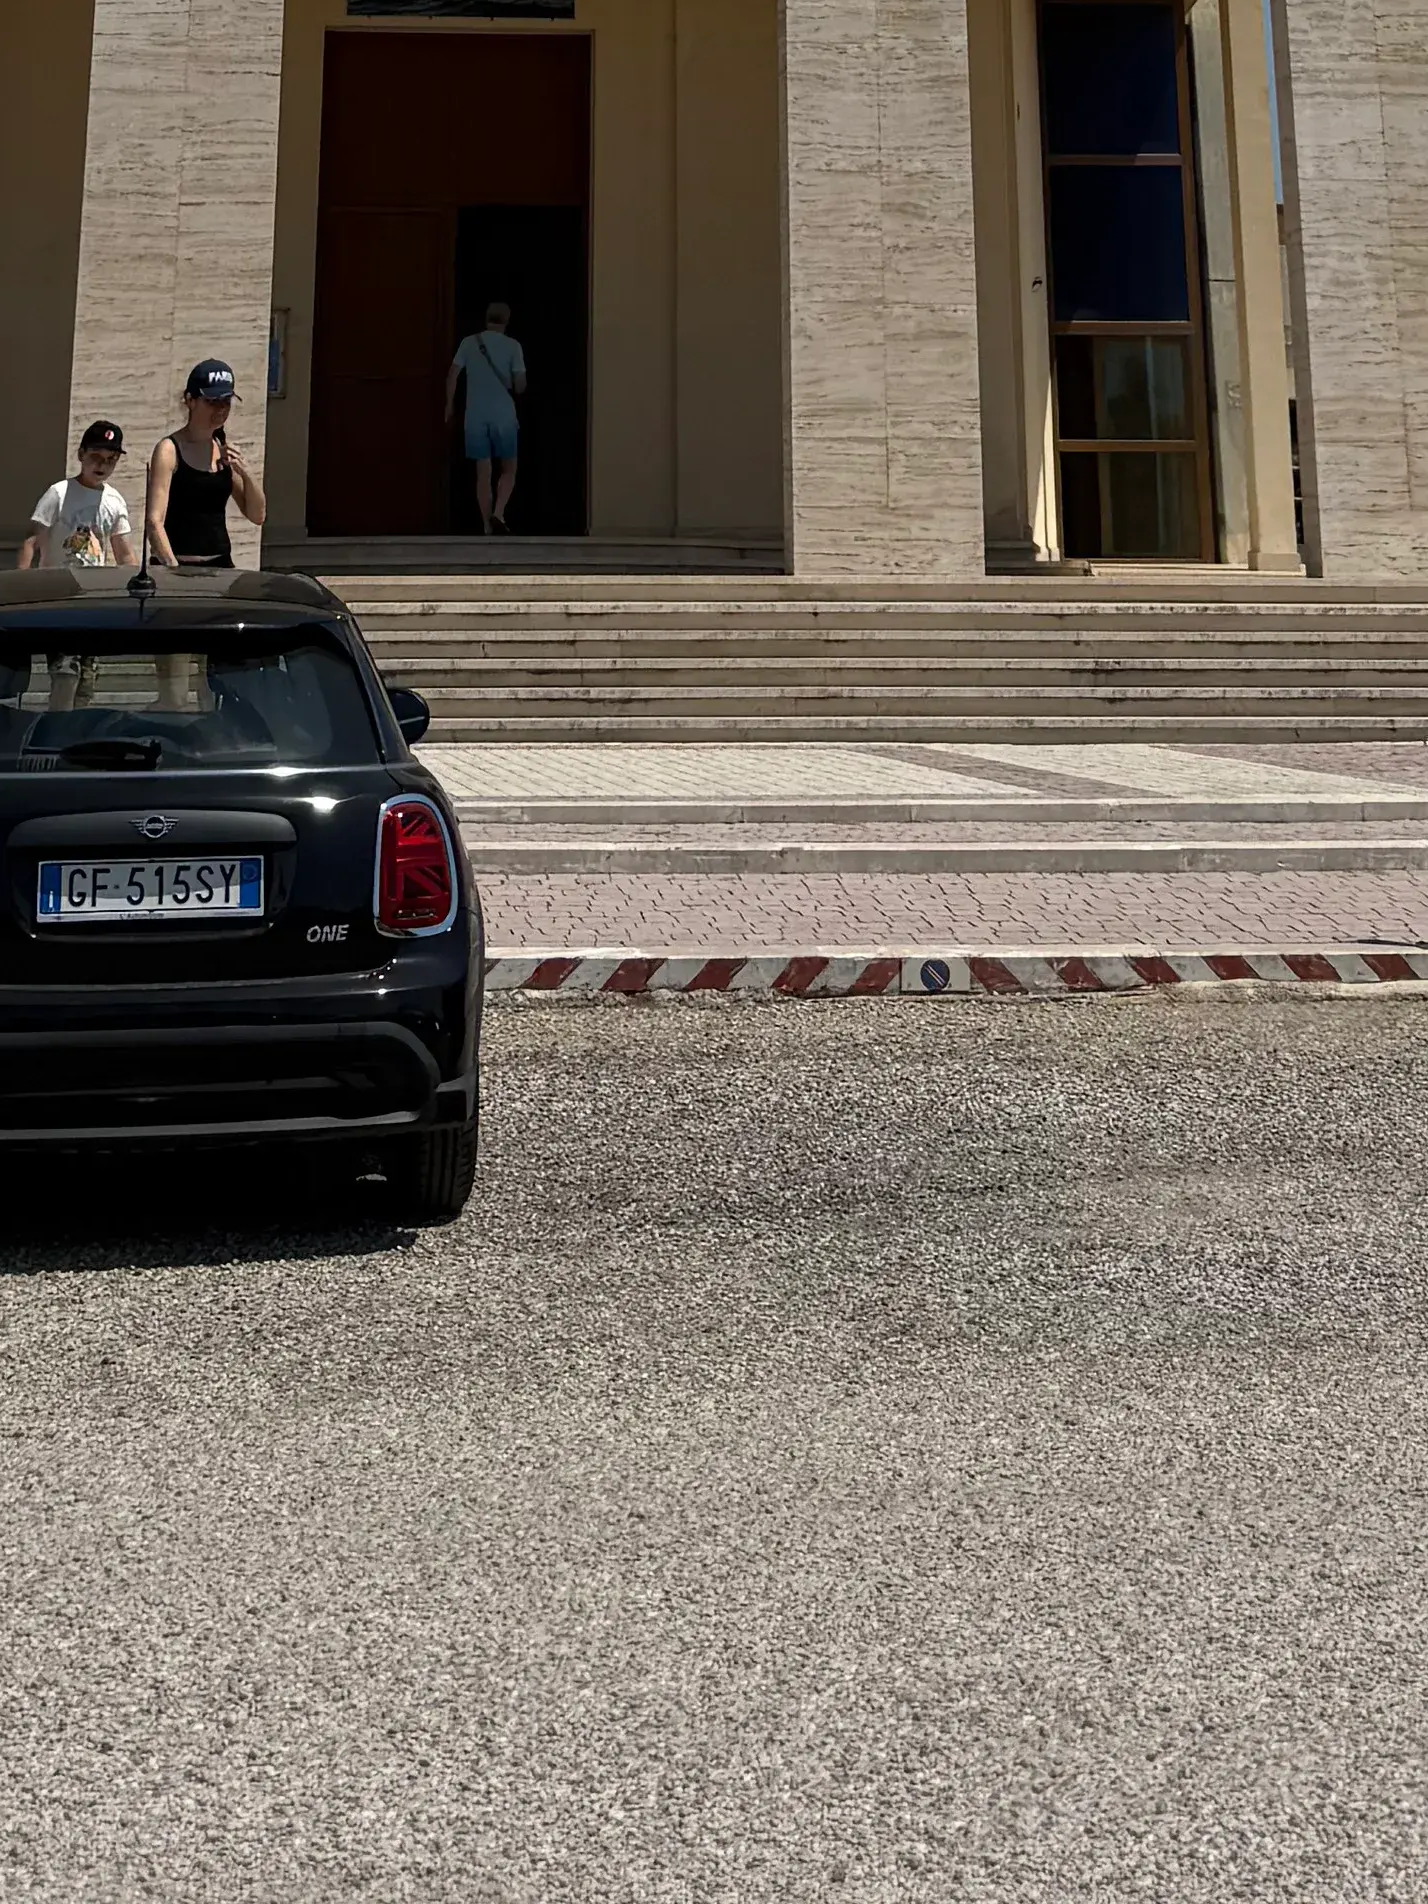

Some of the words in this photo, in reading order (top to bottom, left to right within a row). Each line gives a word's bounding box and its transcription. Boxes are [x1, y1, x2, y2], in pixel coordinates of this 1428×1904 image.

[68, 868, 110, 908] GF
[126, 864, 236, 906] 515SY
[306, 923, 350, 943] ONE
